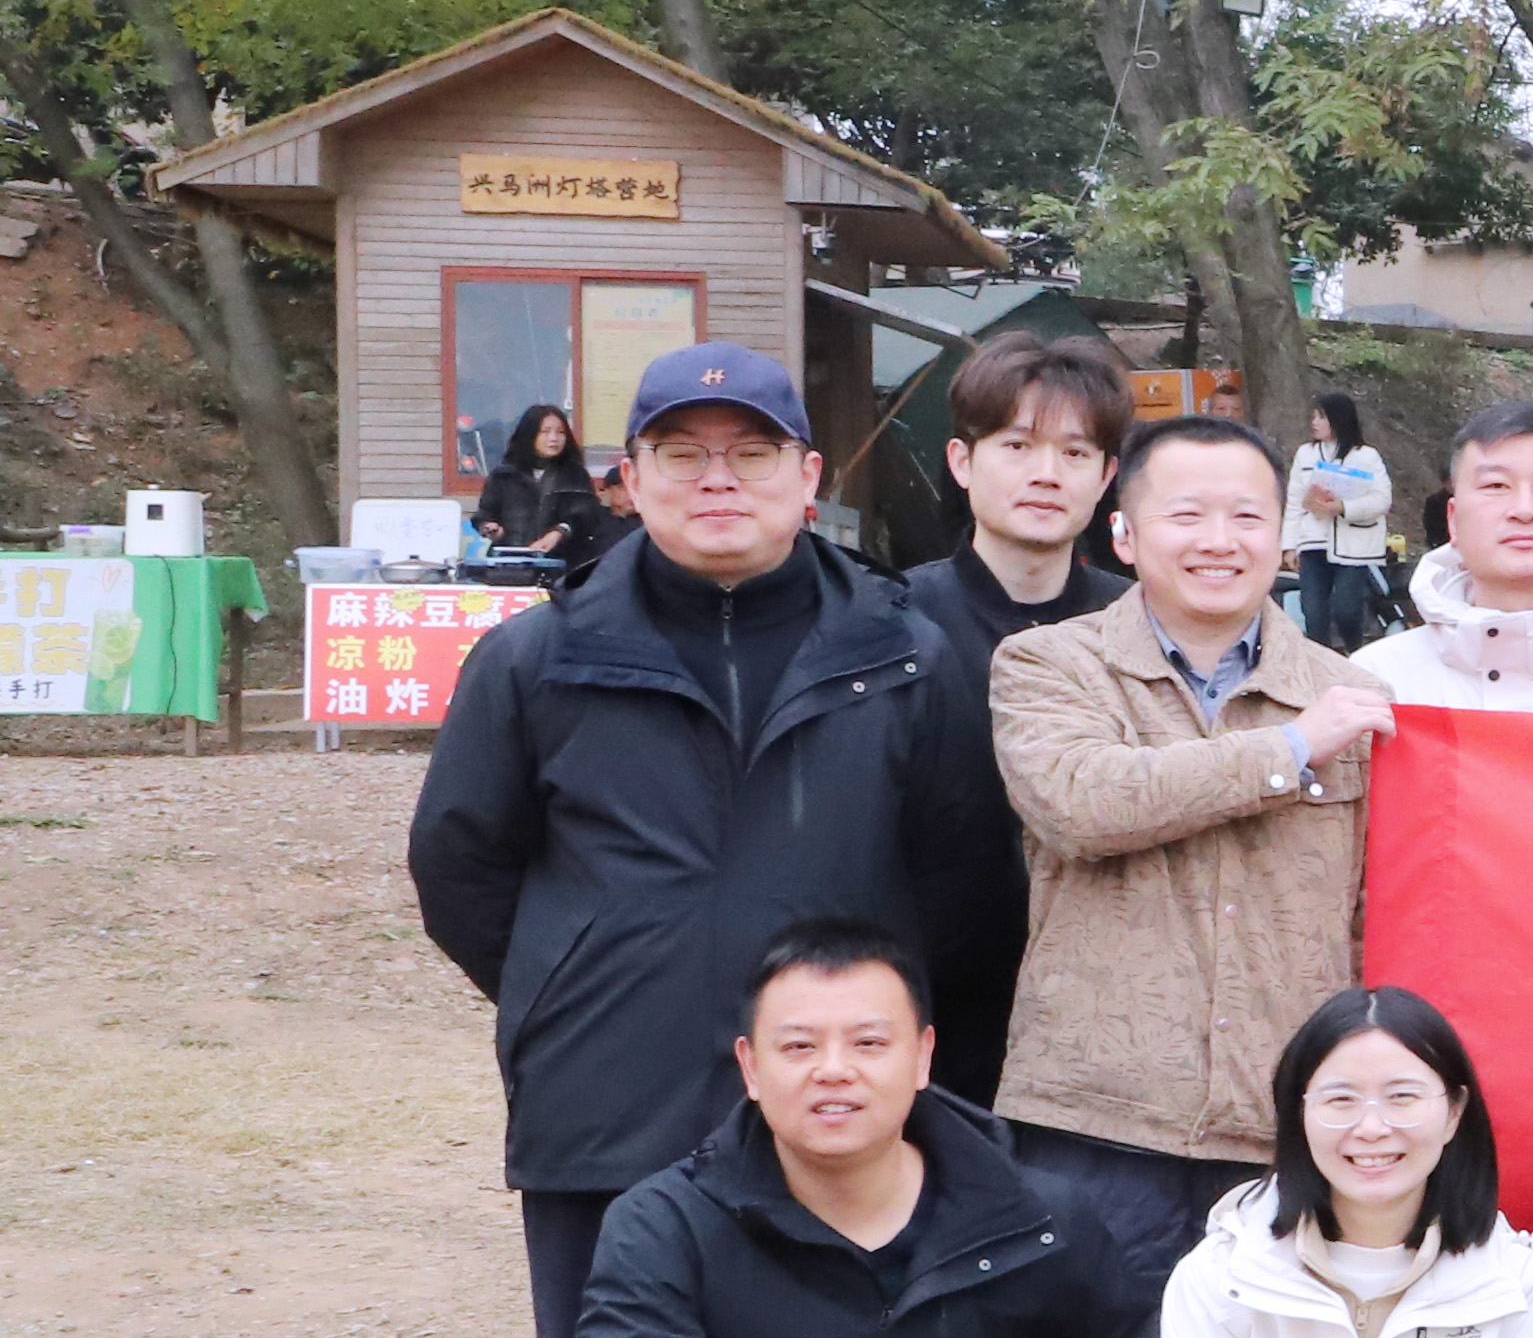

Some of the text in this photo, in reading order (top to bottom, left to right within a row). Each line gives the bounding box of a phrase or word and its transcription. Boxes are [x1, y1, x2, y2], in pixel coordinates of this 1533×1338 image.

[468, 173, 670, 202] 兴马洲灯塔营地
[0, 567, 72, 618] 打
[326, 635, 418, 671] 凉粉
[0, 679, 53, 701] 手打
[325, 677, 430, 716] 油炸
